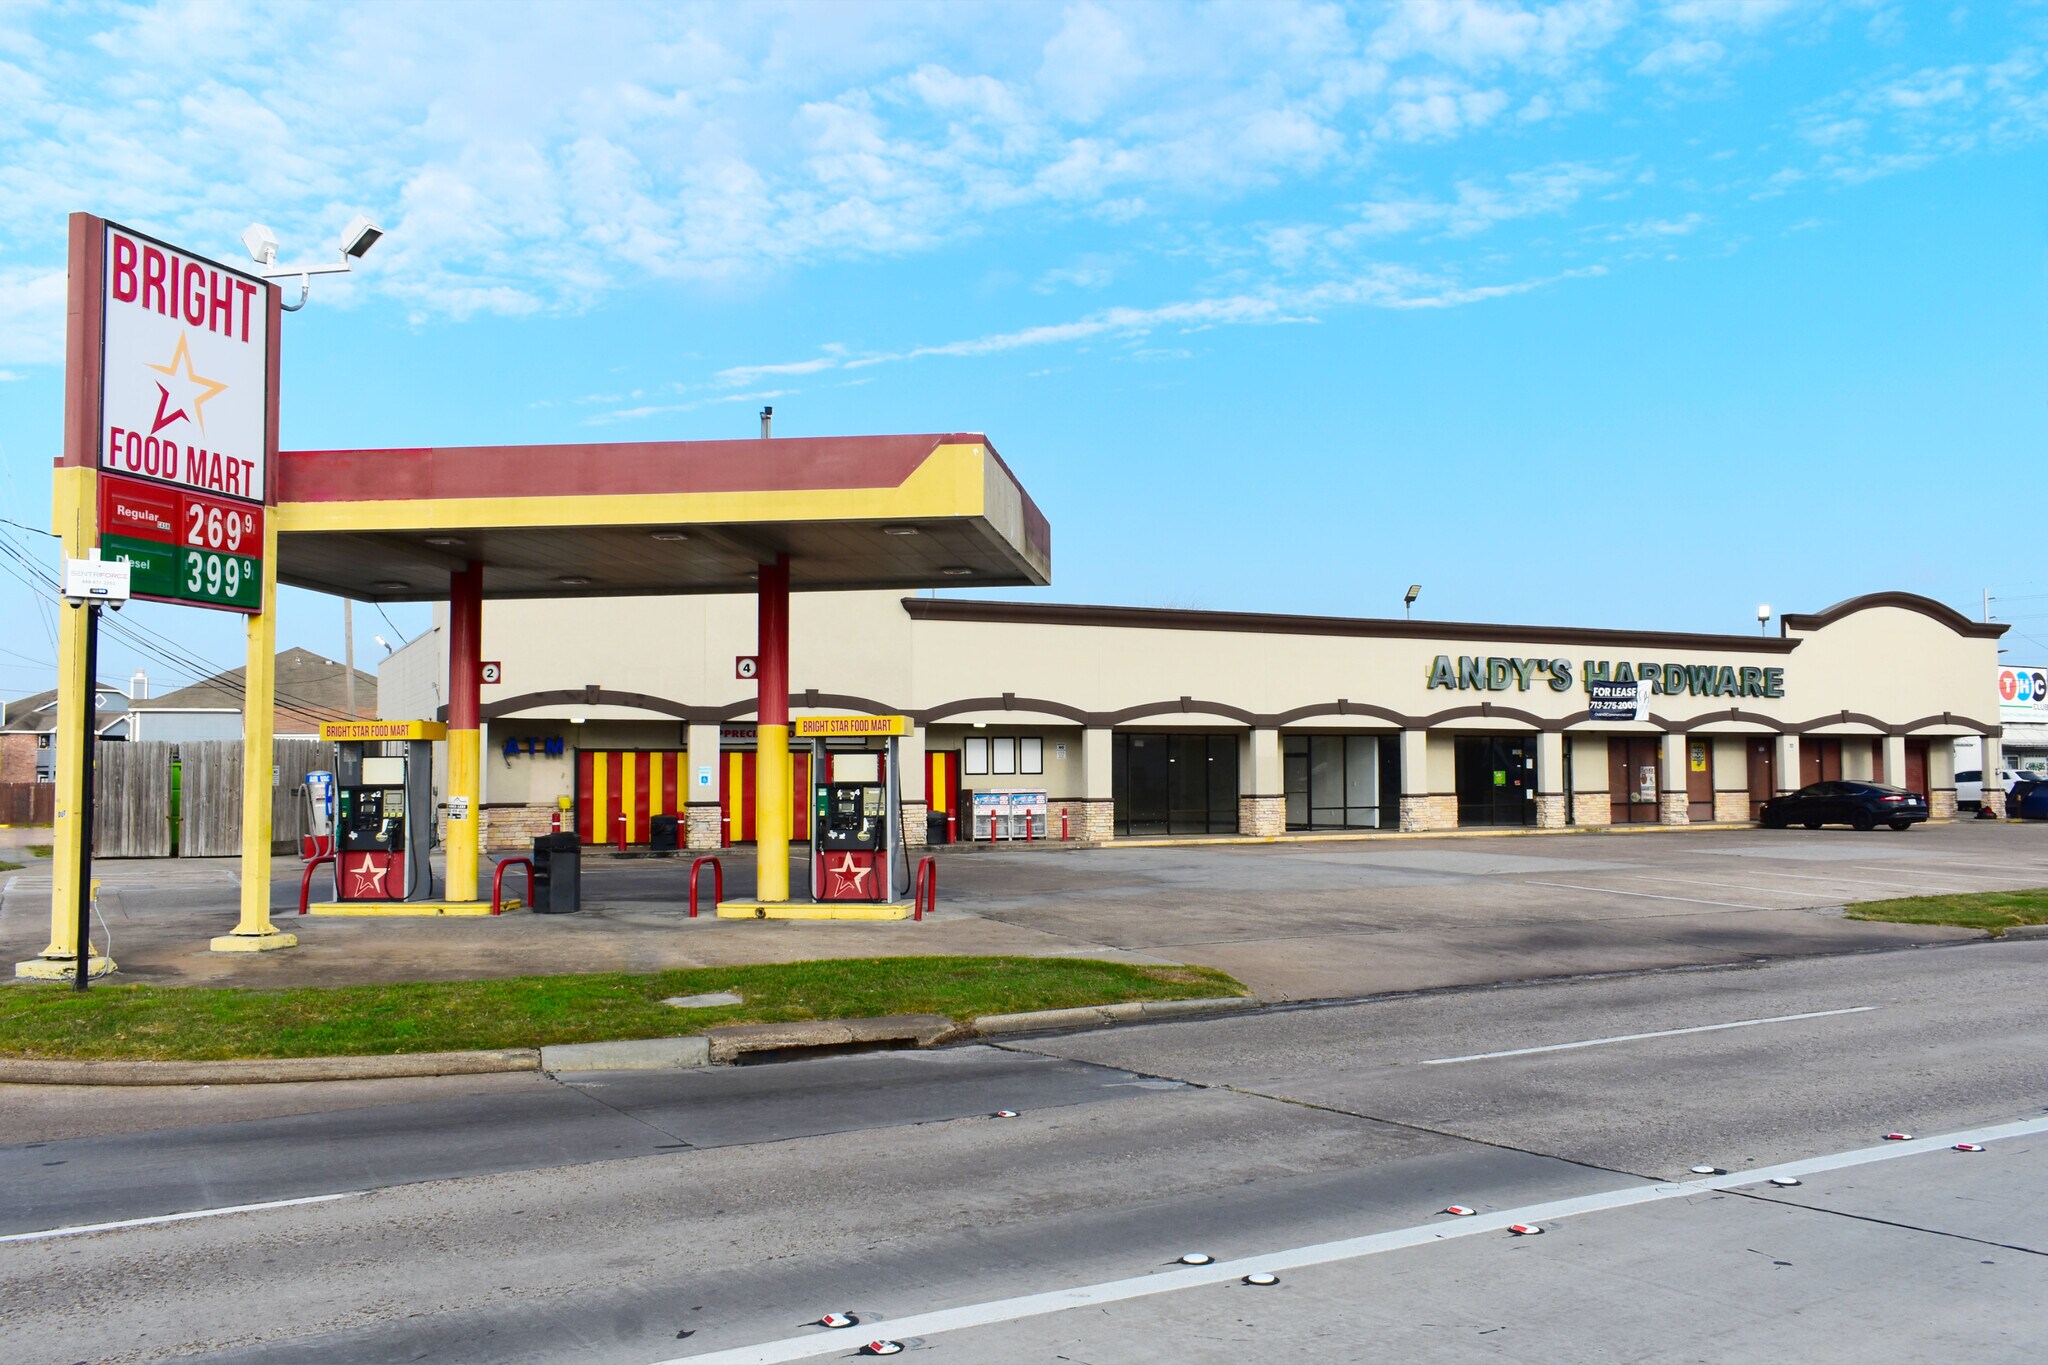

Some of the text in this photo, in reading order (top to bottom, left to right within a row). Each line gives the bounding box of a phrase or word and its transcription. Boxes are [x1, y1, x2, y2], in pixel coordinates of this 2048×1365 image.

[113, 233, 257, 343] BRIGHT
[110, 426, 255, 497] FOOD MART
[117, 505, 159, 522] Regular
[157, 521, 170, 530] CASH
[486, 668, 494, 678] 2
[743, 663, 751, 673] 4
[1427, 655, 1573, 692] ANDY'S
[1593, 687, 1637, 697] FOR LEASE
[326, 725, 409, 737] BRIGHT STAR FOOD MART
[803, 720, 891, 732] BRIGHT STAR FOOD MART
[504, 736, 564, 755] ATM
